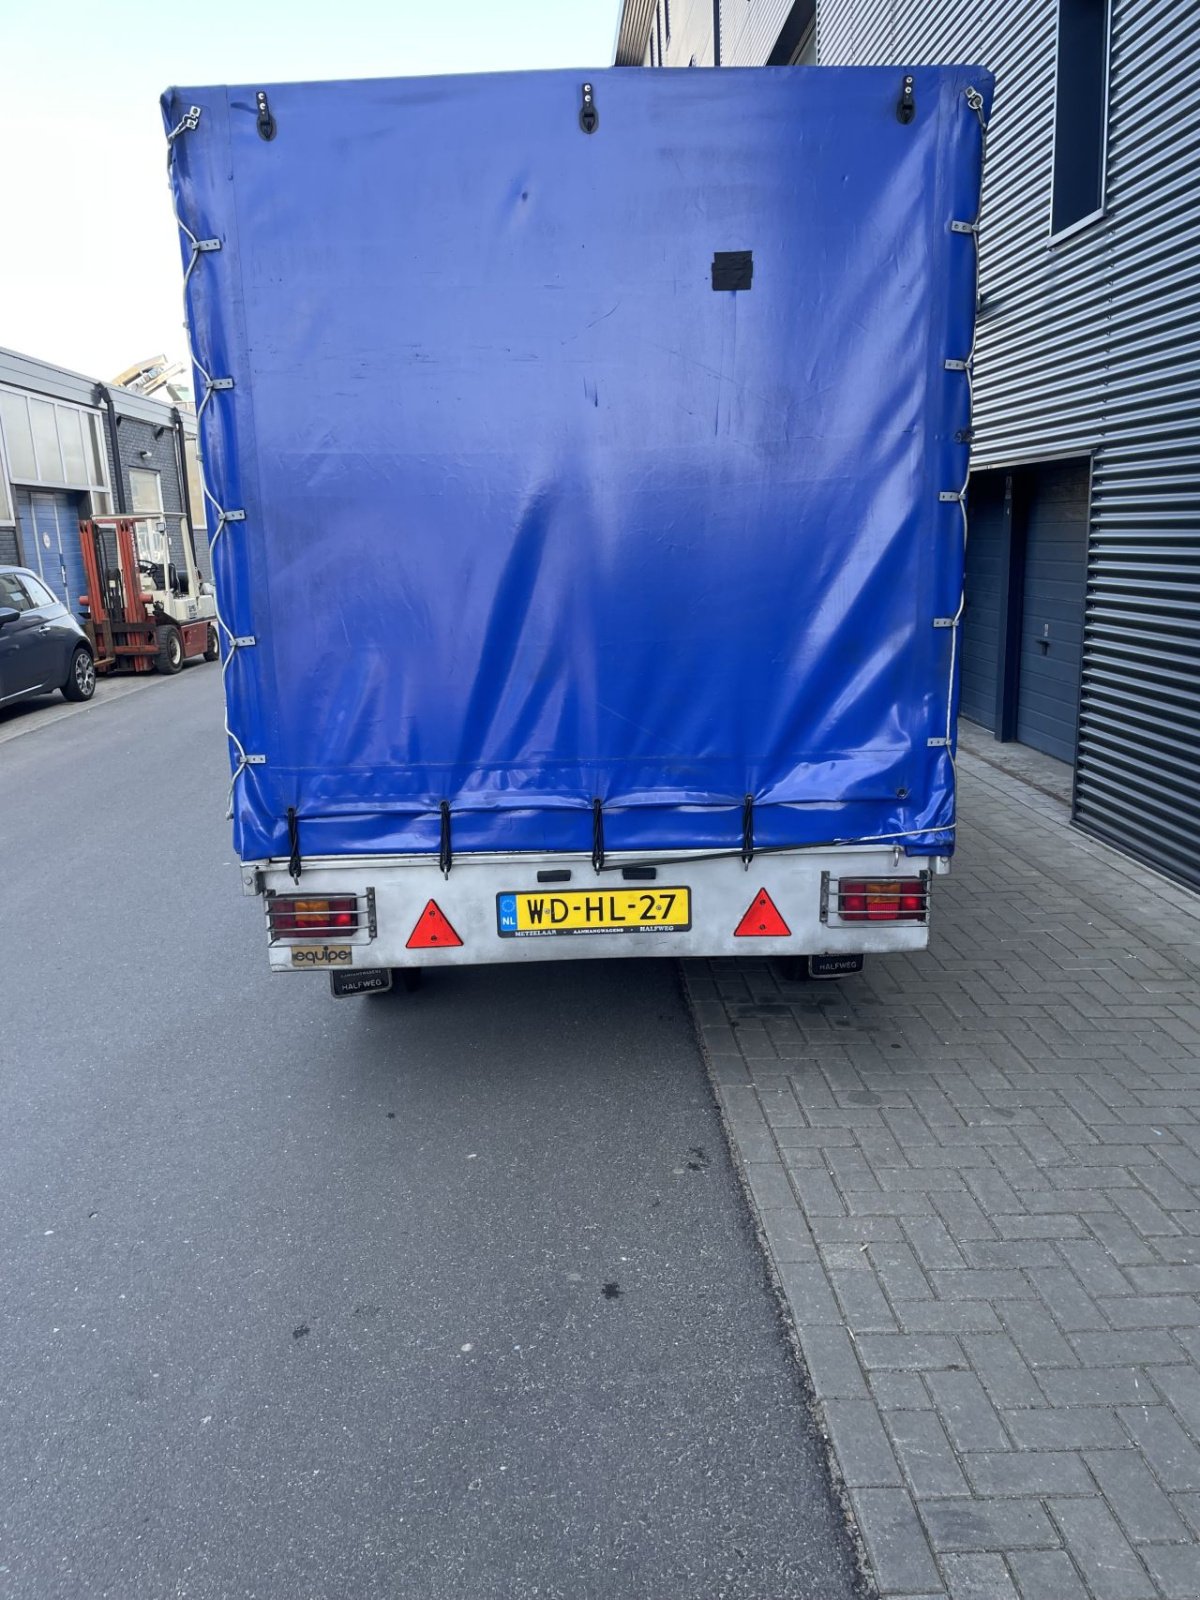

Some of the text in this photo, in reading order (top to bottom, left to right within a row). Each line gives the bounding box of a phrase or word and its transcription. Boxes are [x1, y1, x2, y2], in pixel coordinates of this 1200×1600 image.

[527, 894, 676, 924] WD-HL-27
[502, 917, 517, 925] NL
[295, 946, 348, 963] equipe
[342, 979, 382, 990] HALFWEG
